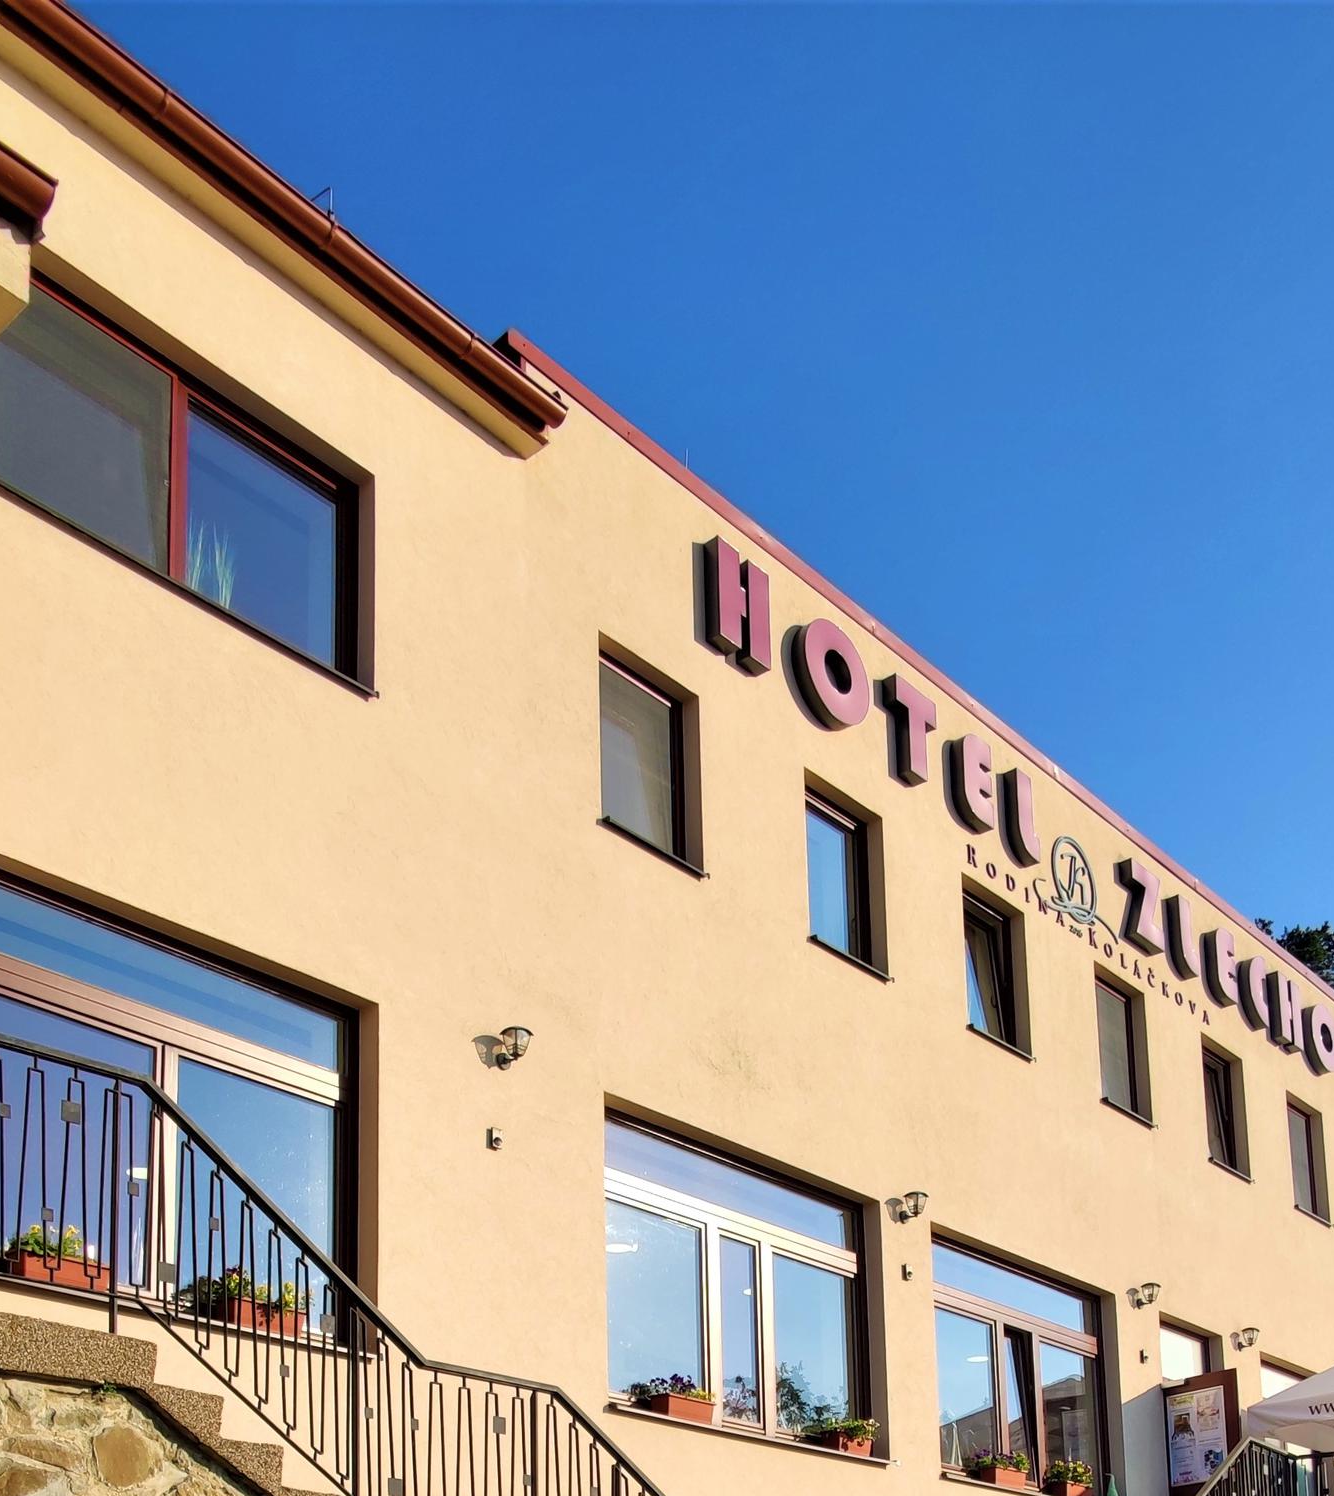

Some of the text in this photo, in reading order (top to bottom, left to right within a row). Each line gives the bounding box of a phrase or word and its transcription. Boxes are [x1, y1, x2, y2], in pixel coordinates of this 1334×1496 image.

[703, 535, 1041, 868] HOTEL
[966, 844, 1210, 1026] RODINA KOLÁČKOVA
